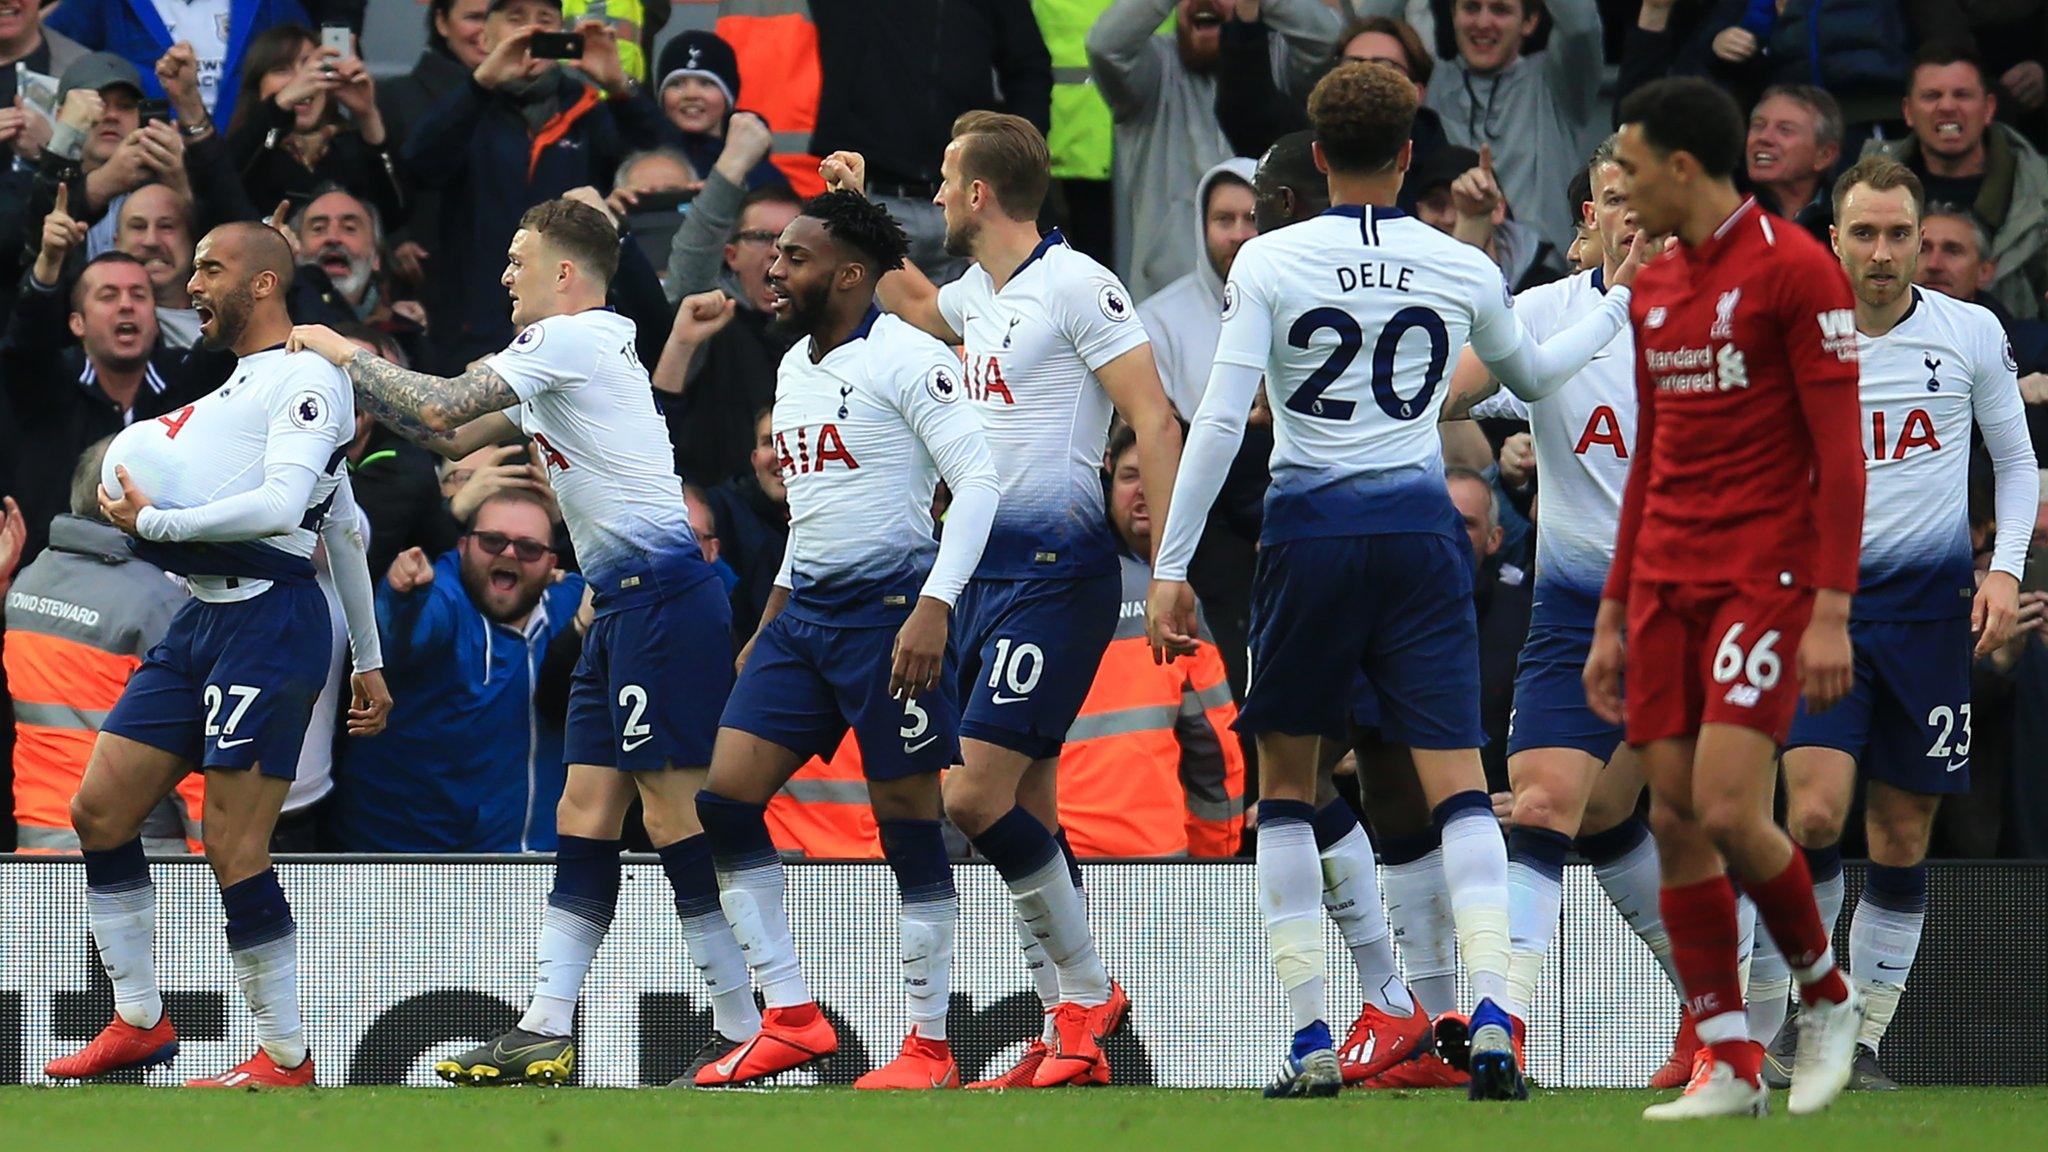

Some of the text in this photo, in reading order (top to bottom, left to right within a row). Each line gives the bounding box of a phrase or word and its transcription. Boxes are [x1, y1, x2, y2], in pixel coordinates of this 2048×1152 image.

[1336, 262, 1414, 293] DELE
[1285, 306, 1450, 421] 20
[1574, 405, 1629, 459] A
[1871, 409, 1942, 460] IA
[37, 597, 100, 627] STEWARD
[988, 638, 1045, 694] 10
[1712, 622, 1782, 690] 66
[203, 684, 262, 737] 27
[618, 684, 651, 737] 2
[1926, 702, 1971, 757] 23
